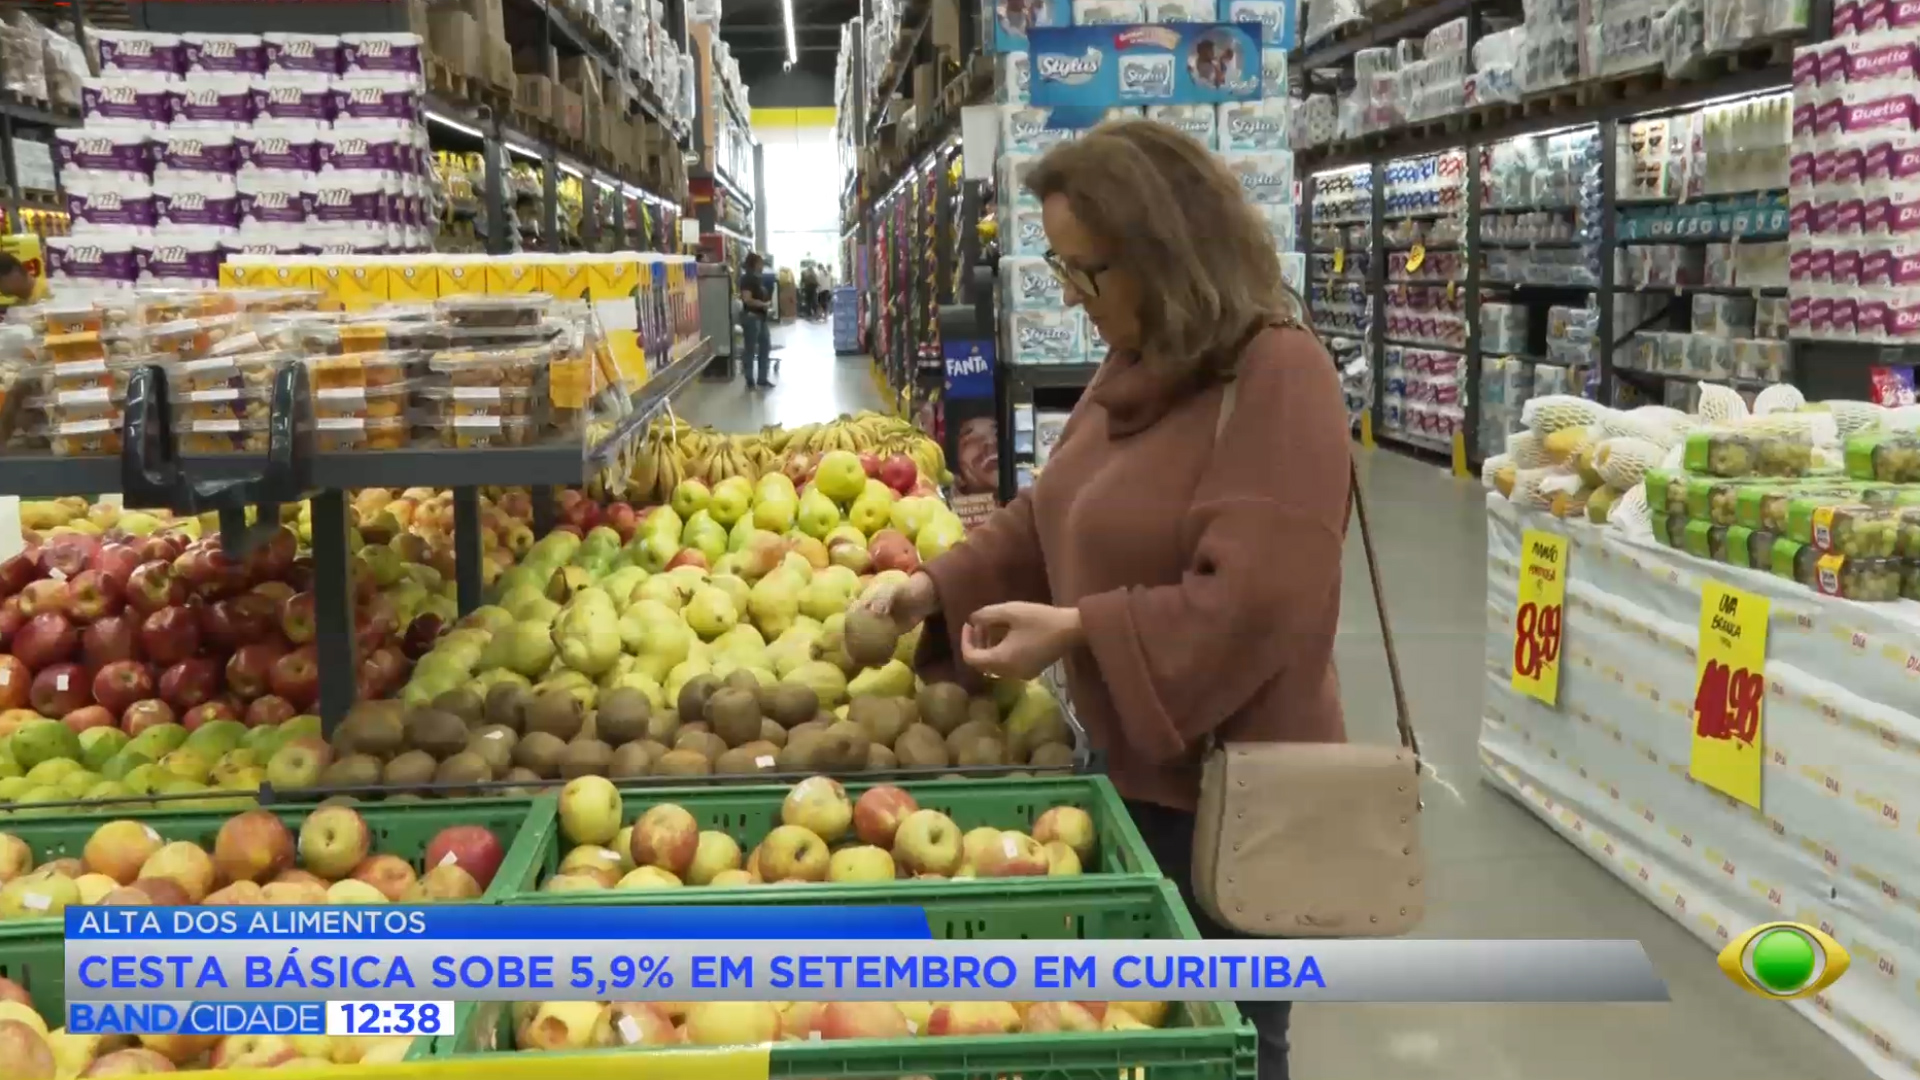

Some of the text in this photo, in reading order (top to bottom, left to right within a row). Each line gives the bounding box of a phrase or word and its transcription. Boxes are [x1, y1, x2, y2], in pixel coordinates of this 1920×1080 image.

[1041, 57, 1099, 79] Stylus
[1855, 51, 1909, 69] Duetto
[1851, 101, 1906, 121] Duetto
[73, 138, 114, 157] Mili
[164, 138, 203, 157] Mili
[252, 138, 291, 155] Mili
[330, 138, 368, 156] Mili
[1242, 173, 1283, 189] tylus
[84, 192, 124, 211] Mili
[168, 193, 206, 210] Mili
[314, 189, 352, 206] Mili
[63, 245, 103, 263] Mili
[150, 245, 188, 263] Mili
[946, 355, 988, 377] FANTA
[1718, 593, 1739, 617] UVA
[1852, 633, 1866, 648] DIA
[1825, 776, 1839, 793] DIA
[1882, 803, 1898, 821] DIA
[1768, 889, 1782, 905] DIA
[1879, 957, 1895, 976] DIA
